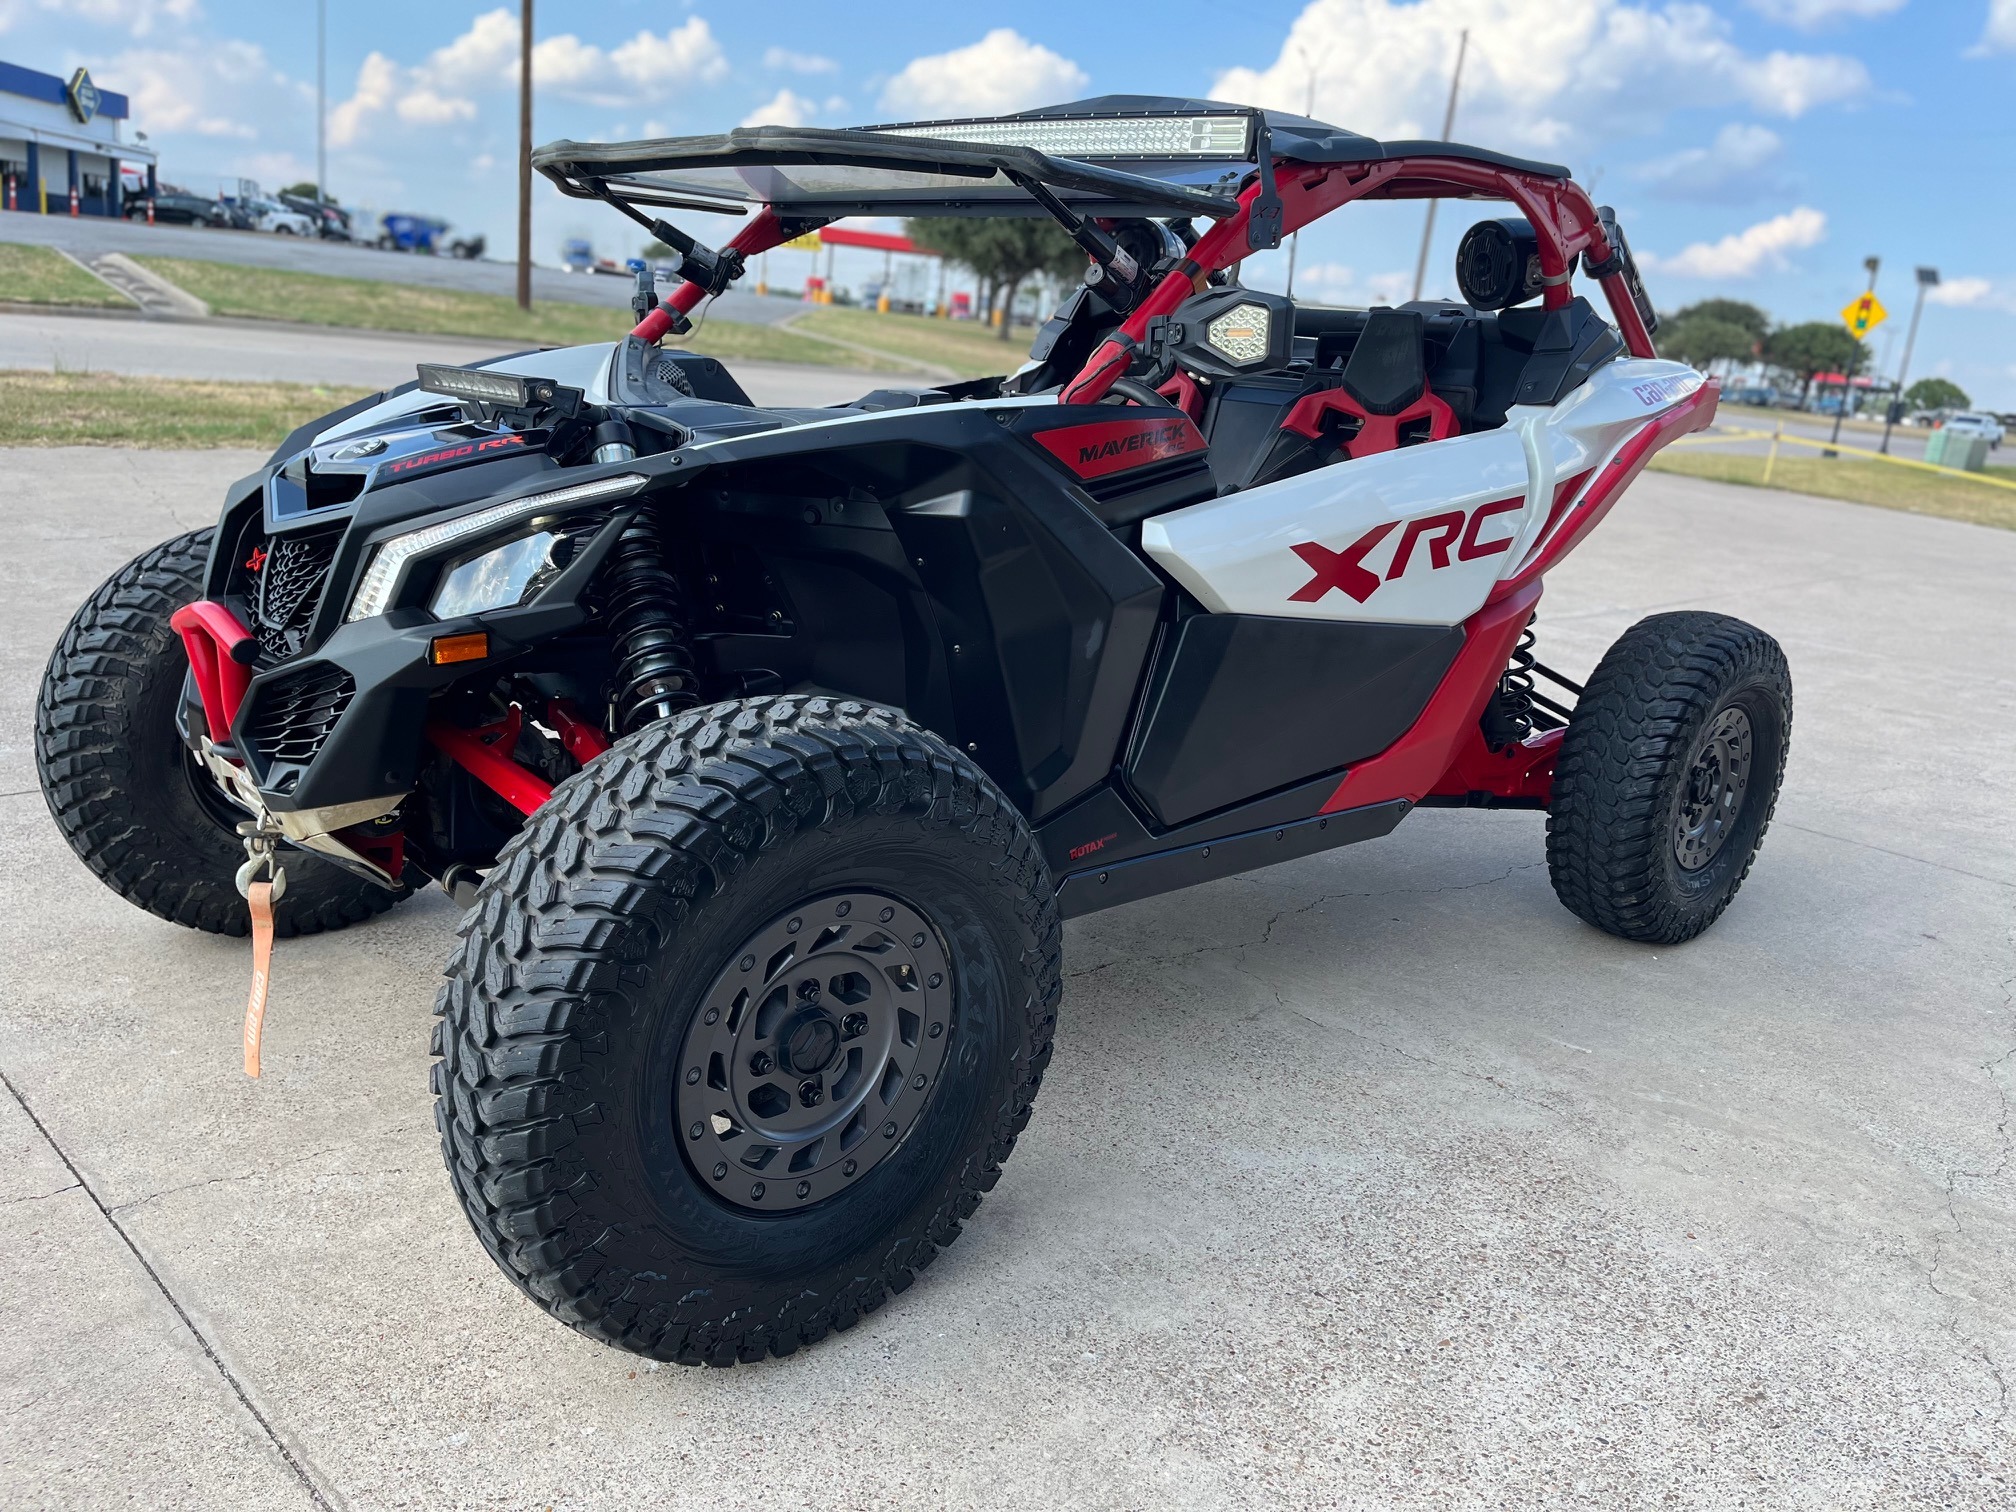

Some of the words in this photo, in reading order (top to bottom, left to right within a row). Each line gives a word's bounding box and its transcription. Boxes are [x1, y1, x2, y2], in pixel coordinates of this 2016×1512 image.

[390, 445, 474, 473] TURBO
[478, 434, 525, 451] RR
[1079, 422, 1186, 464] MAVERICK
[1286, 494, 1526, 604] XRC
[1069, 838, 1105, 861] ROTAX
[246, 969, 267, 1047] can-am
